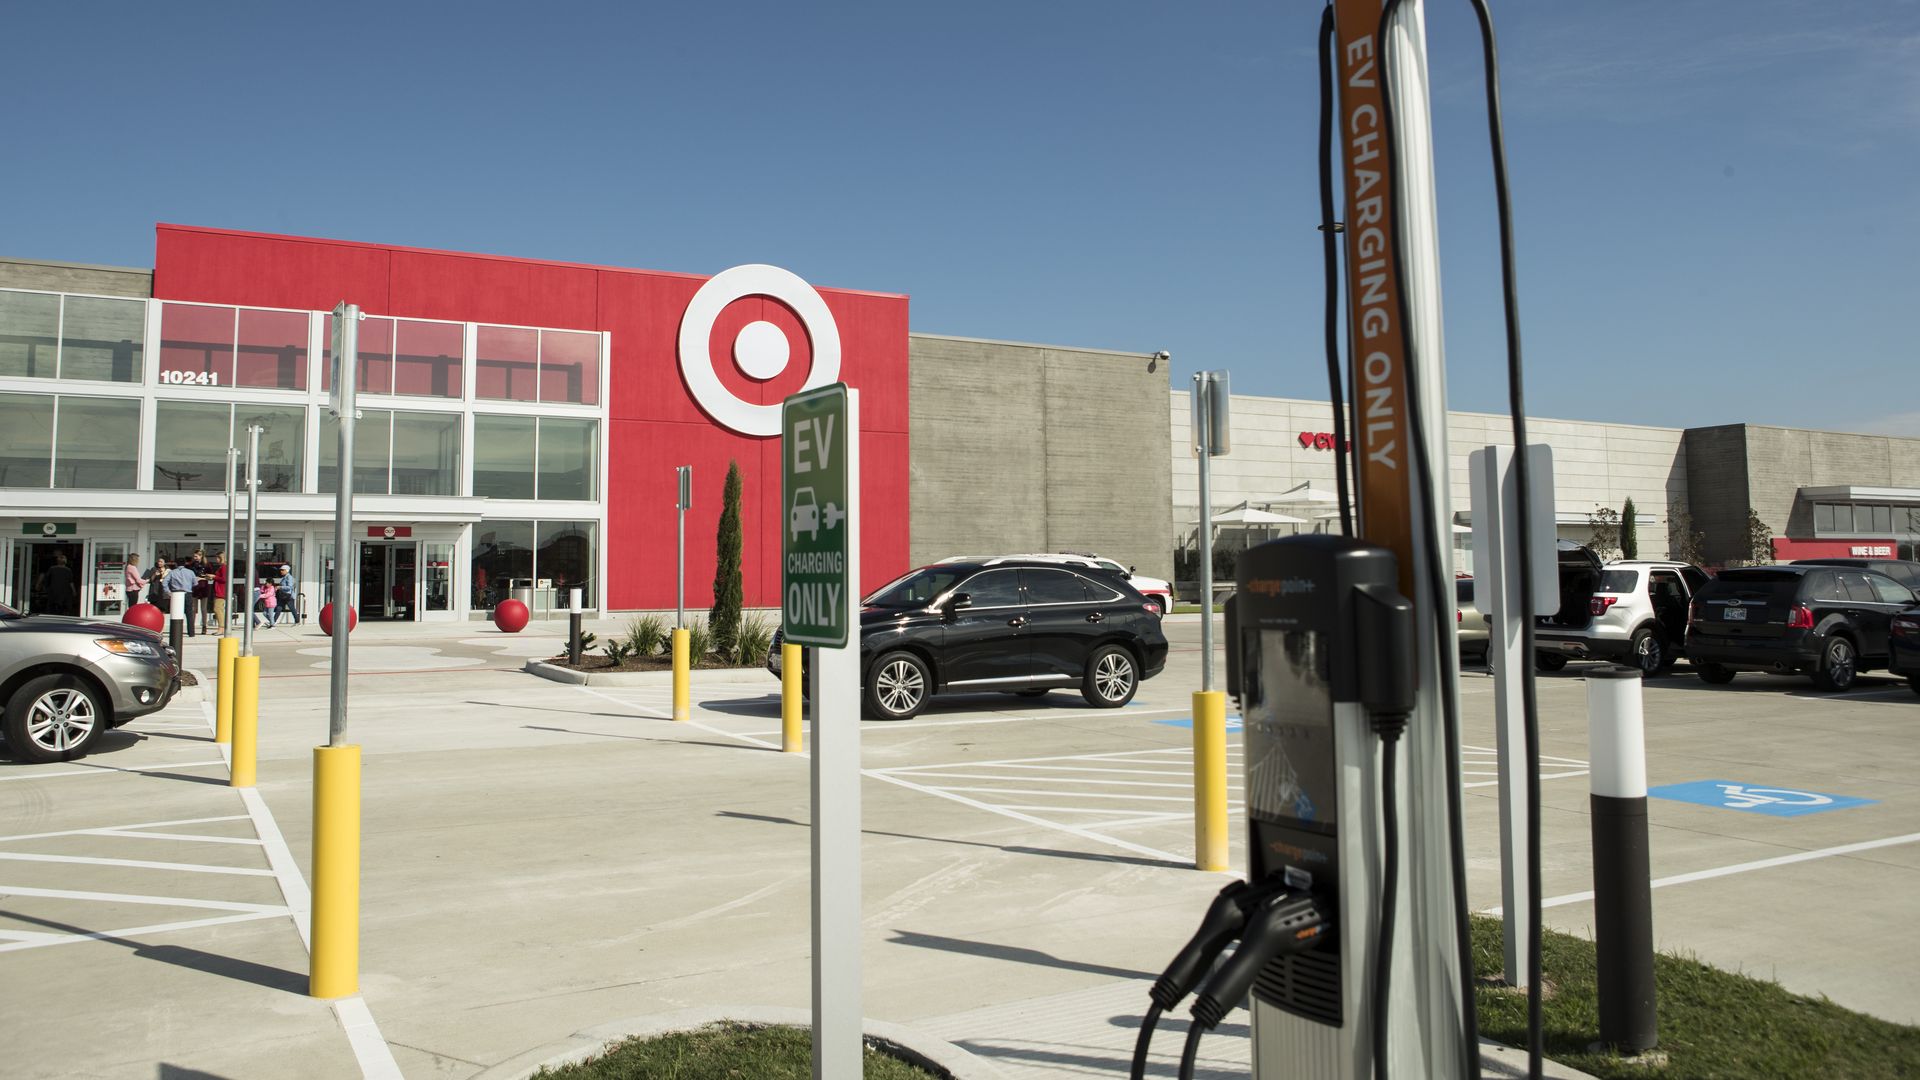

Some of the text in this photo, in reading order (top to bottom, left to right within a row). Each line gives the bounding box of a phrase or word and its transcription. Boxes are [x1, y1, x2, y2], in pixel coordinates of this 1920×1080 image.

[1347, 34, 1397, 471] EV CHARGING ONLY
[160, 370, 218, 386] 10241
[794, 414, 834, 474] EV
[787, 552, 842, 574] CHARGING
[1851, 546, 1868, 556] WINE
[1873, 547, 1891, 556] BEER
[788, 582, 840, 627] ONLY
